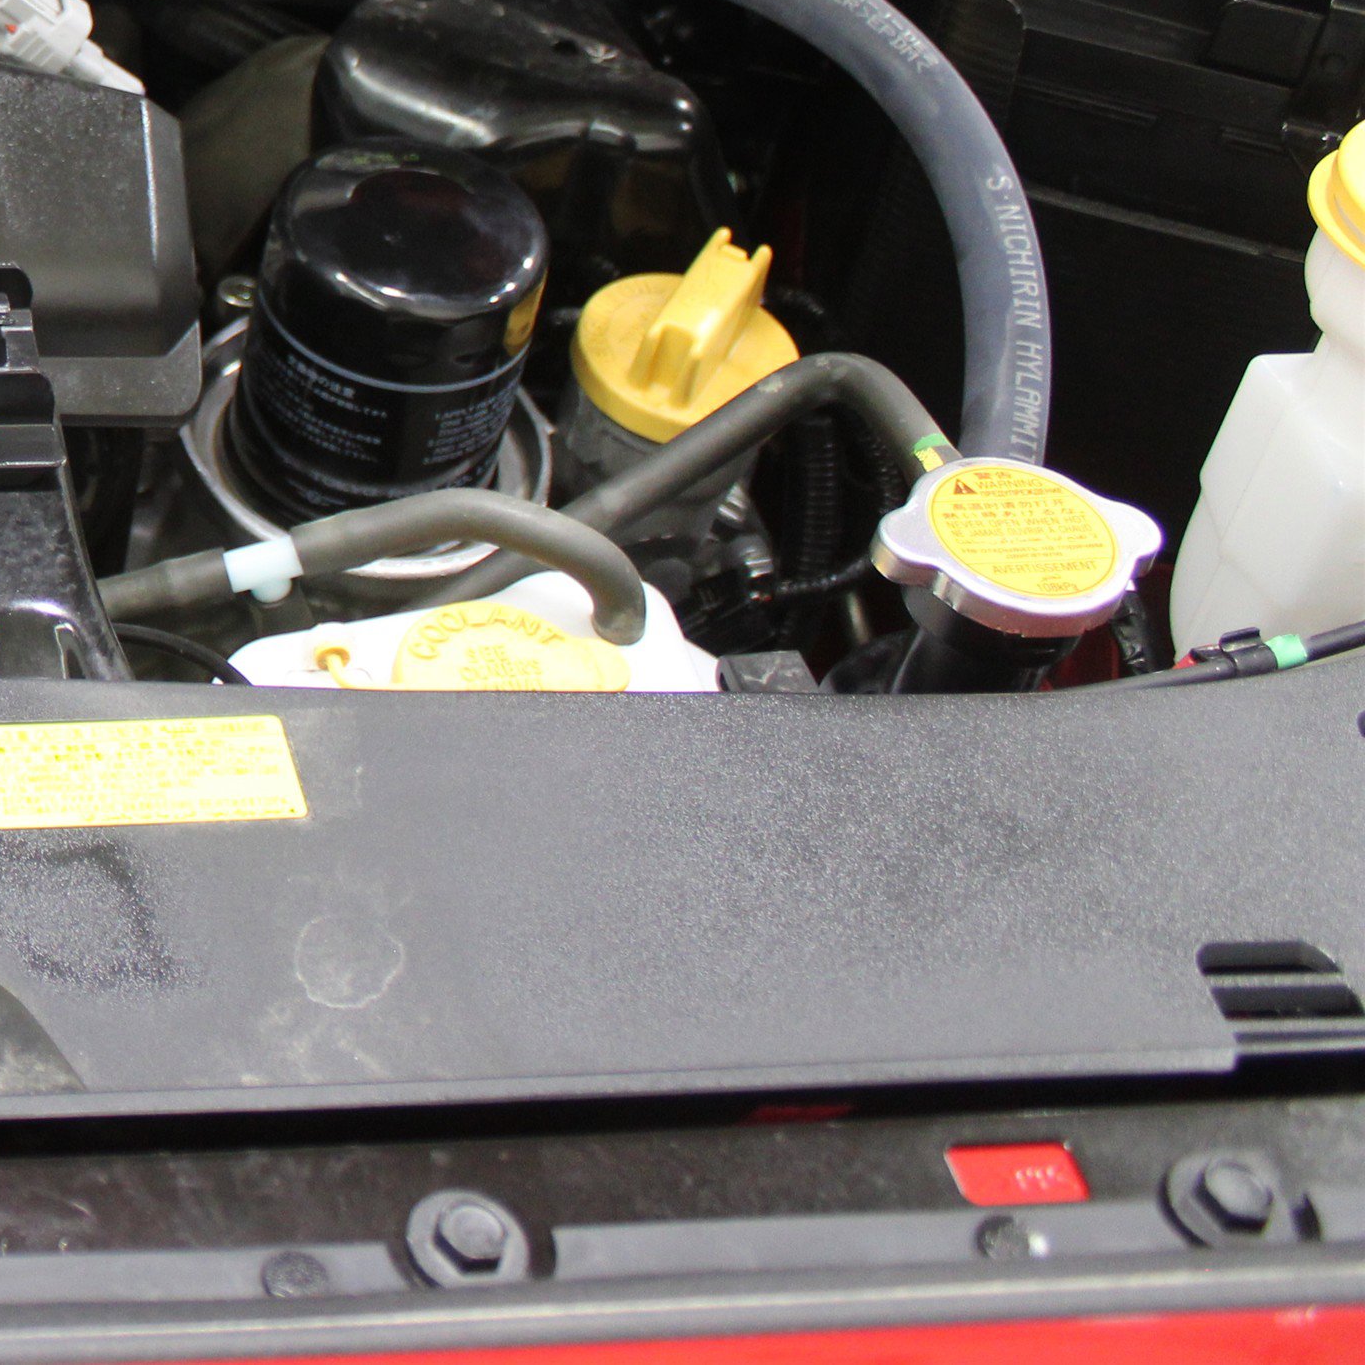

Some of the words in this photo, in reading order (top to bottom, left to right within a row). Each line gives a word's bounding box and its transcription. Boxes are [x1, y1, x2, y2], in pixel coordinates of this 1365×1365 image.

[975, 479, 1043, 489] WARNING
[946, 520, 983, 529] NEVER
[989, 519, 1021, 527] OPEN
[1025, 517, 1060, 525] WHEN
[1064, 515, 1086, 523] HOT
[970, 528, 1004, 537] JAMAIS
[1007, 527, 1044, 536] OUVRIR
[1059, 524, 1093, 533] CHAUD
[992, 560, 1098, 574] AVERTISSEMENT
[407, 607, 566, 660] COOLANT
[466, 644, 507, 663] SEE
